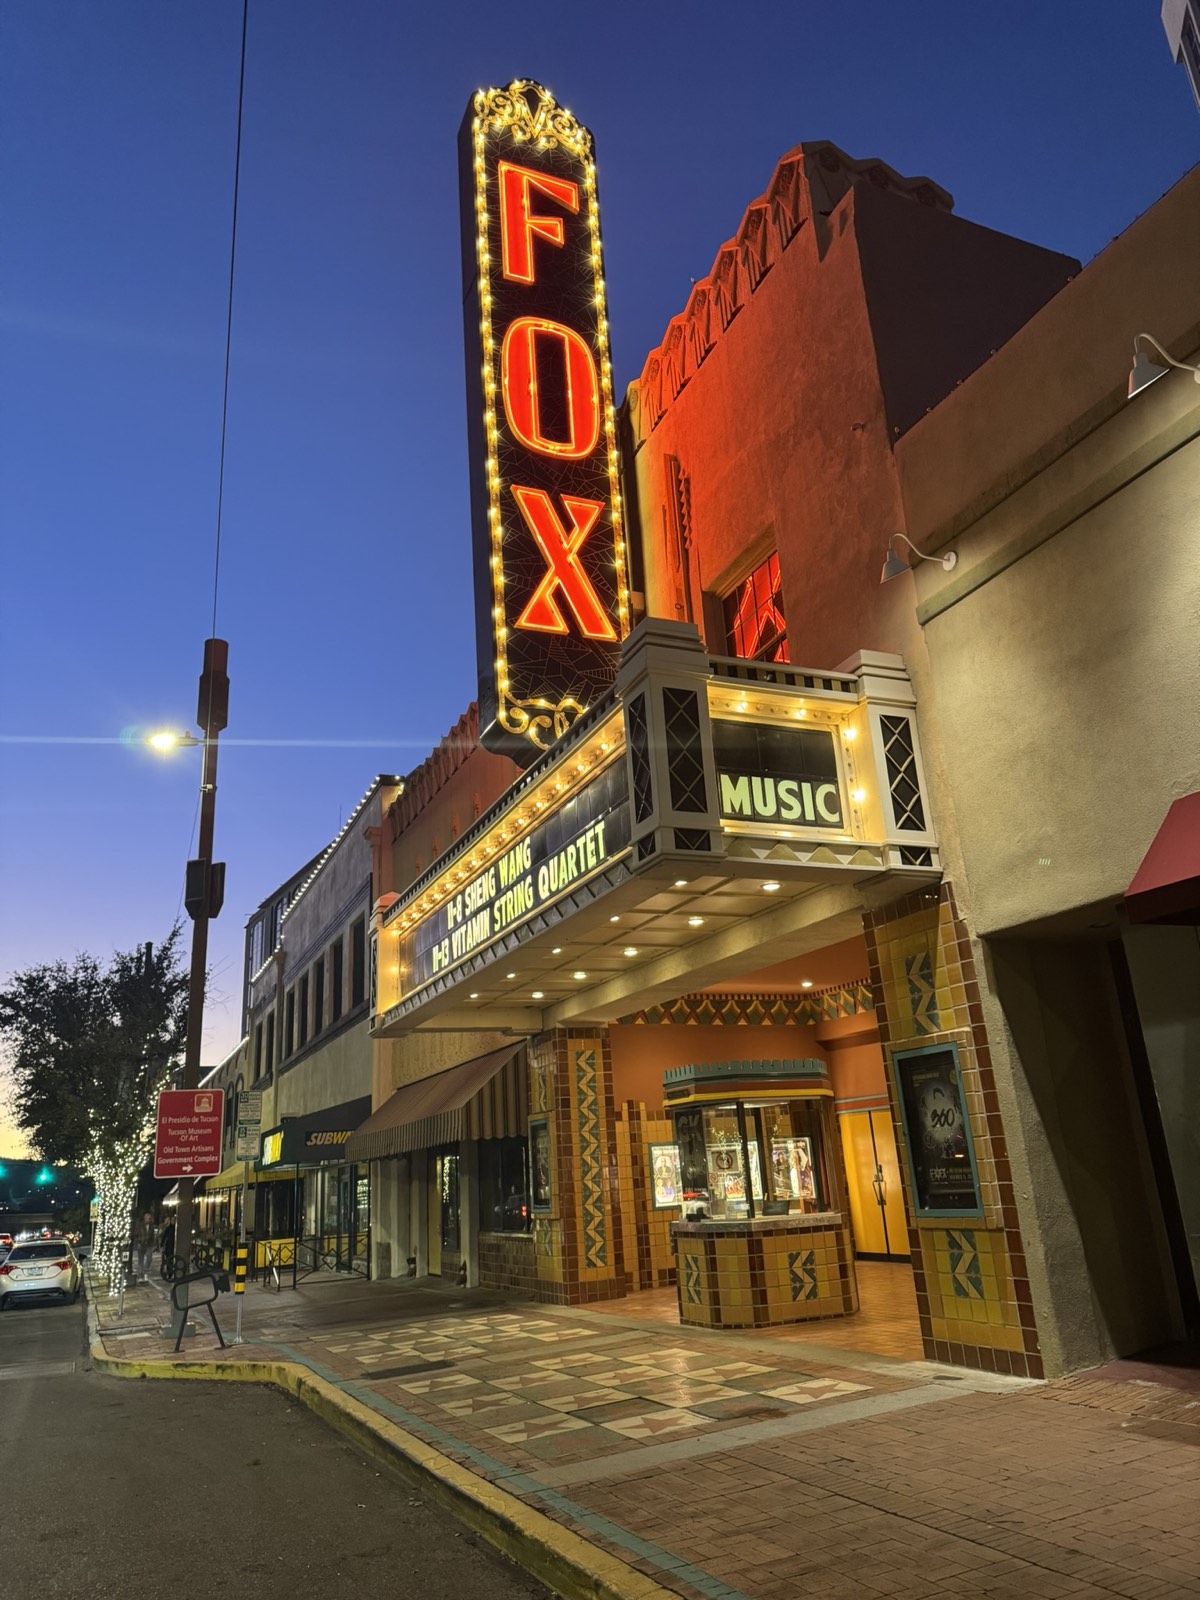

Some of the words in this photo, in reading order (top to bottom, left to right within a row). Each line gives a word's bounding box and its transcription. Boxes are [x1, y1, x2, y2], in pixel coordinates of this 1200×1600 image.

[498, 160, 618, 643] FOX
[720, 774, 840, 823] MUSIC
[465, 866, 496, 916] SHENG
[499, 836, 532, 889] WANG
[451, 907, 490, 960] VITAMIN
[493, 875, 533, 932] STRING
[537, 820, 606, 900] QUARTET
[169, 1116, 190, 1124] Presidio
[931, 1108, 955, 1128] 360
[168, 1128, 187, 1136] Tucson
[189, 1134, 199, 1142] Art
[306, 1131, 354, 1147] SUBW
[158, 1156, 193, 1164] Government
[194, 1155, 219, 1163] Complex
